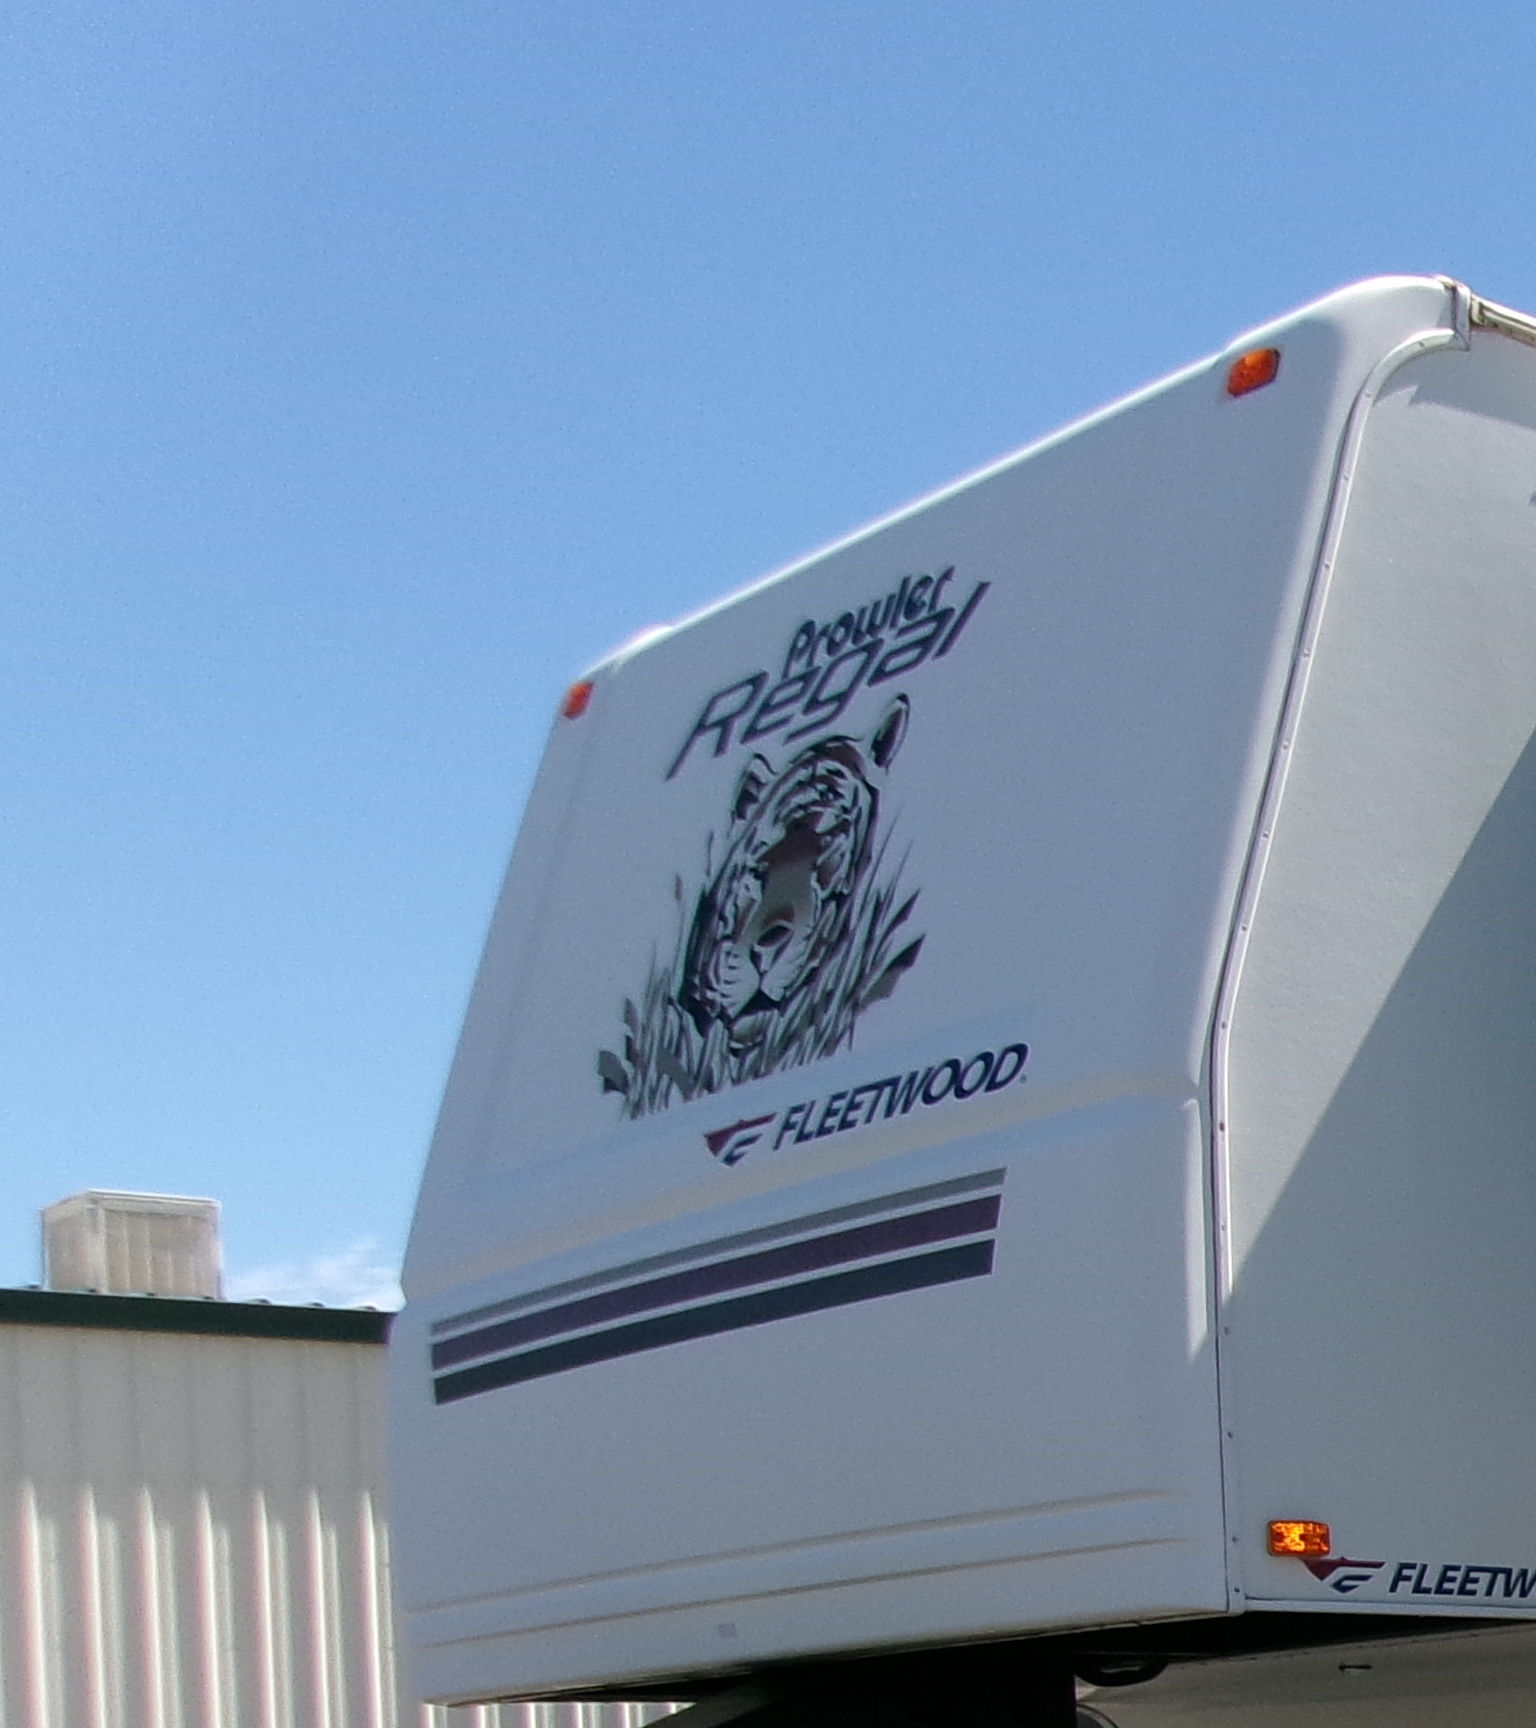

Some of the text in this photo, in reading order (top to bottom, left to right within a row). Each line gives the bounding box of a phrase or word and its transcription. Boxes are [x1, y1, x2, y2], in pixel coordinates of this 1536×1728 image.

[783, 565, 955, 680] Prowler
[664, 580, 991, 782] Regal
[772, 1043, 1029, 1151] FLEETWOOD
